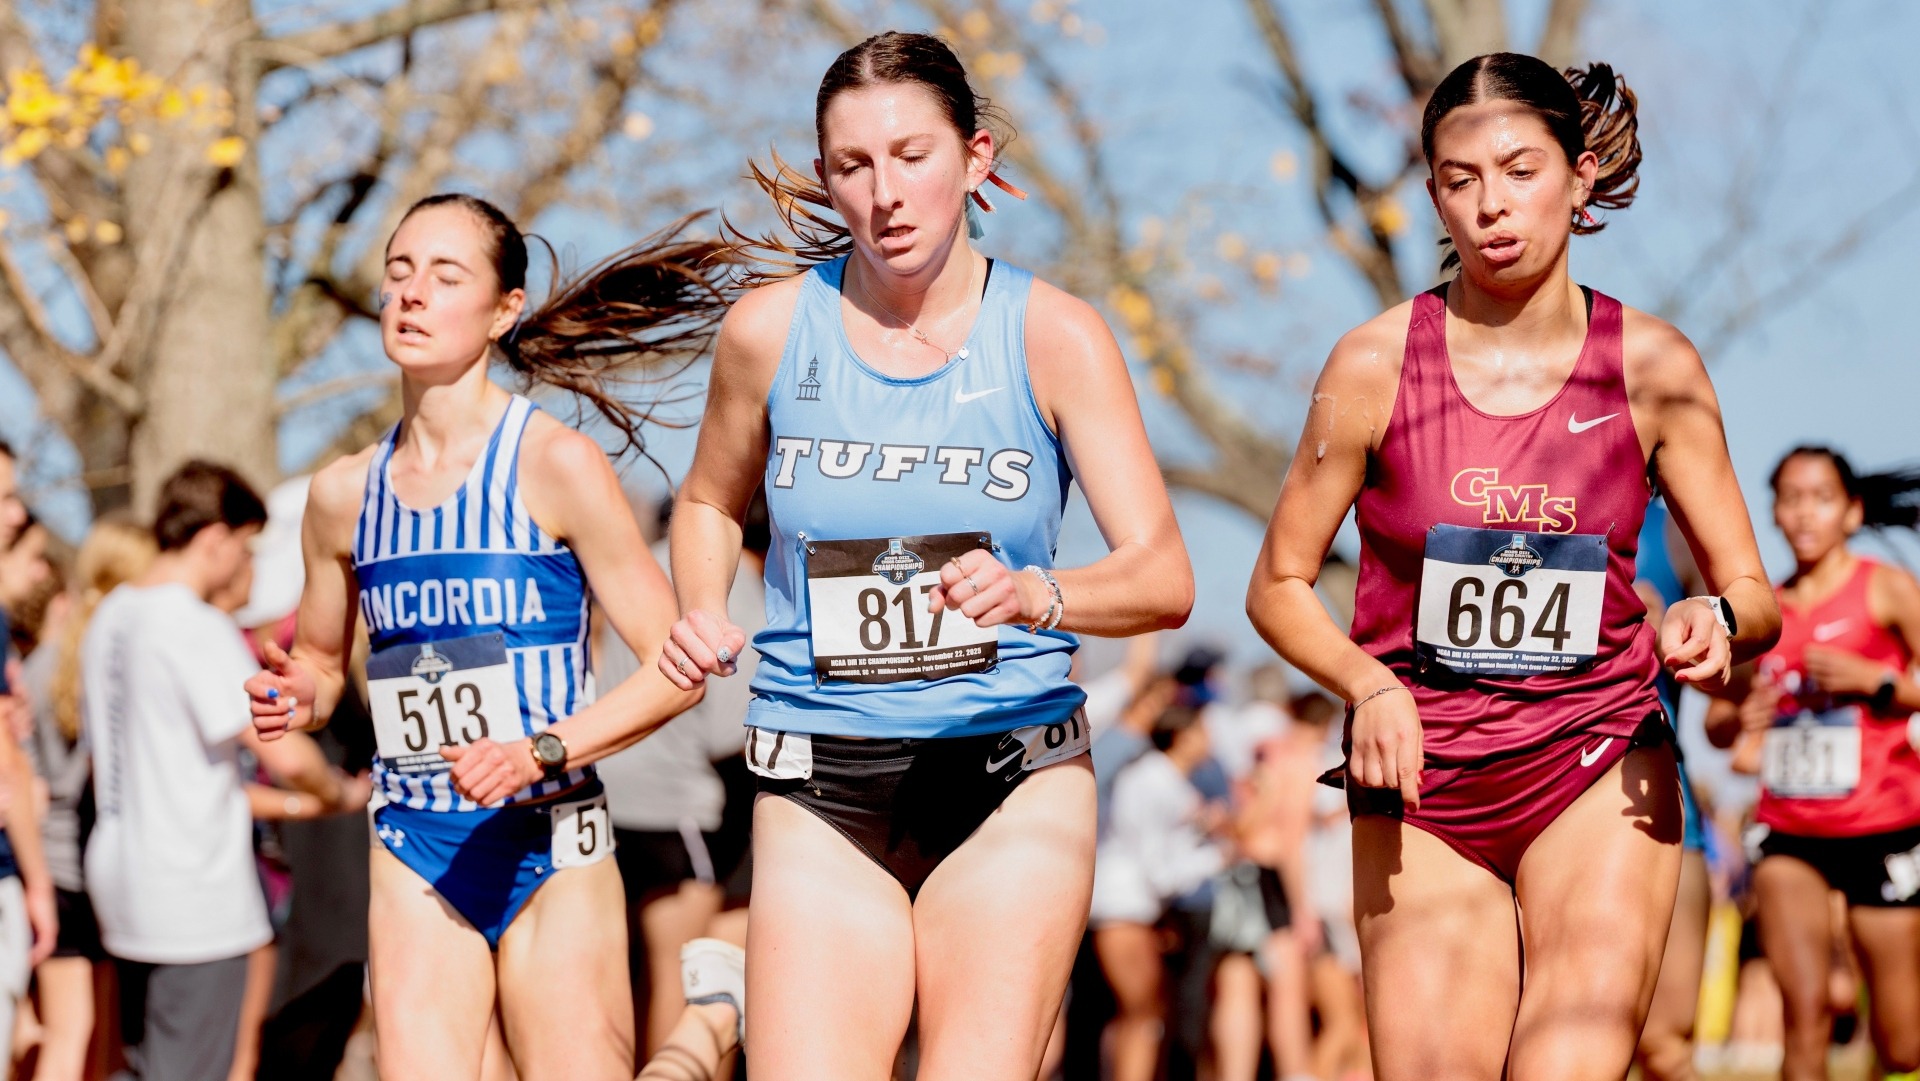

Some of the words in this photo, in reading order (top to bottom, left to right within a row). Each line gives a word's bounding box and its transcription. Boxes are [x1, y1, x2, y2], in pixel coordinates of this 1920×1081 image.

[774, 435, 1034, 501] TUFTS
[1451, 468, 1577, 534] CMS
[874, 561, 923, 571] CHAMPIONSHIPS
[1491, 556, 1541, 566] CHAMPIONSHIPS
[858, 583, 944, 651] 817
[1447, 576, 1572, 652] 664
[830, 659, 846, 667] NCAA
[868, 656, 914, 665] CHAMPIONSHIPS
[923, 652, 953, 662] November
[954, 650, 965, 658] 22,
[966, 646, 982, 656] 2025
[922, 664, 934, 672] Park
[949, 660, 968, 668] Country
[969, 657, 986, 665] Course
[1436, 648, 1451, 657] NCAA
[1471, 652, 1514, 660] CHAMPIONSHIPS
[1521, 653, 1550, 662] November
[1551, 655, 1561, 663] 22,
[1562, 656, 1578, 664] 2025
[1542, 664, 1560, 672] Country
[398, 683, 489, 752] 513
